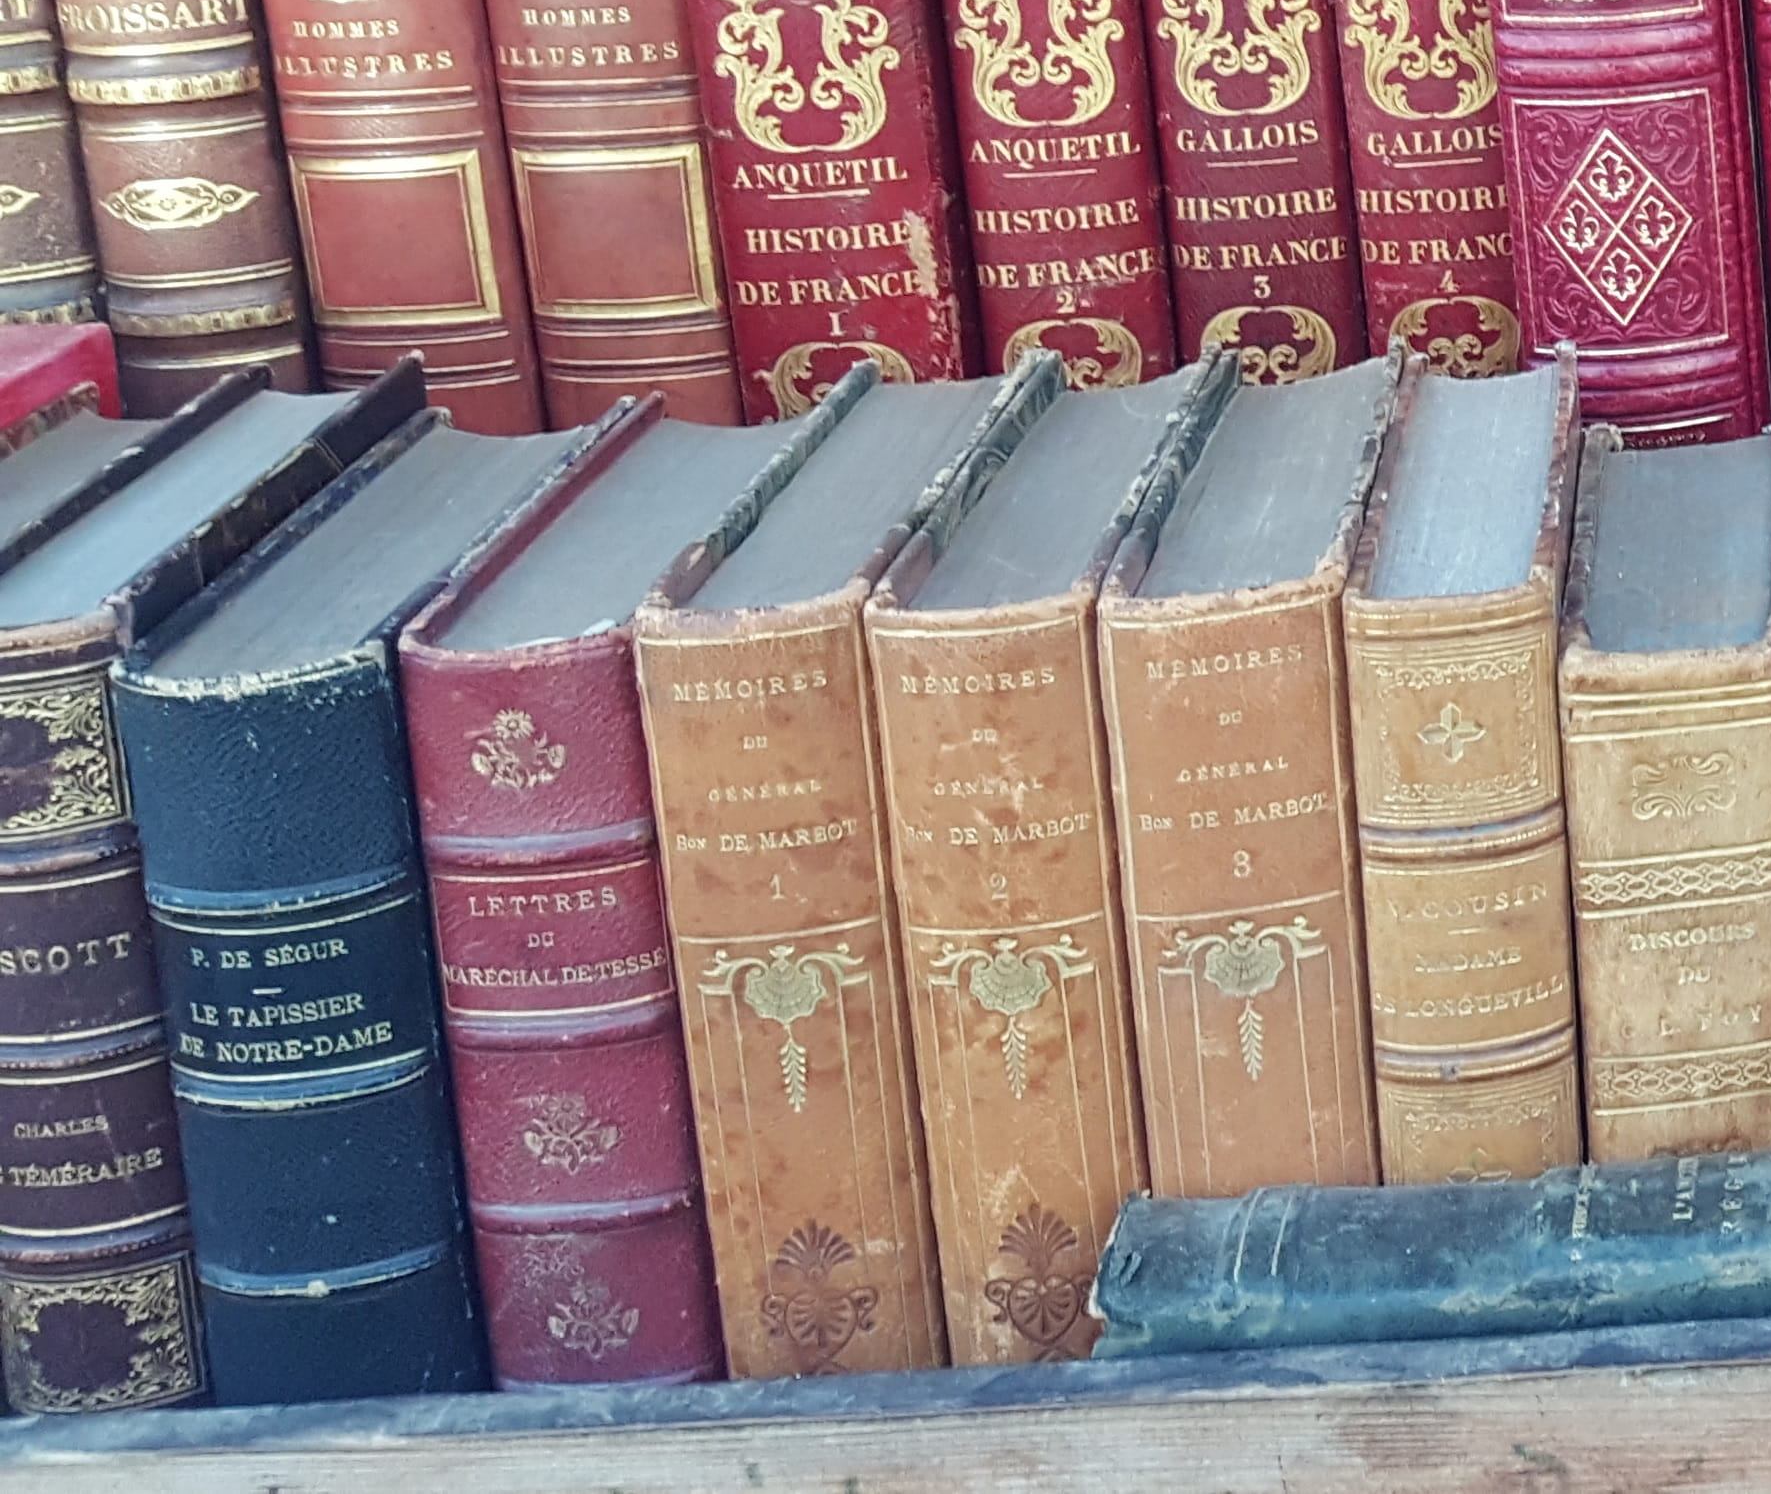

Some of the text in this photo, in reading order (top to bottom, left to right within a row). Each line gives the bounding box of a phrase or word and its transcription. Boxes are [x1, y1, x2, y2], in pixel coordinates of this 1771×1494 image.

[292, 18, 401, 39] HOMMES
[522, 5, 632, 27] HOMMES
[276, 49, 455, 79] ILLUSTRES
[499, 41, 681, 67] ILLUSTRES
[970, 130, 1142, 170] ANQUETIL
[1176, 118, 1320, 155] GALLOIS
[1367, 122, 1503, 157] GALLOIS
[732, 156, 909, 195] ANQUETIL
[976, 197, 1140, 235] HISTOIRE
[1175, 186, 1337, 222] HISTOIRE
[745, 219, 914, 255] HISTOIRE
[978, 244, 1156, 289] DE FRANCE
[1174, 235, 1348, 272] DE FRANCE
[735, 268, 922, 306] DE FRANCE
[1253, 274, 1272, 299] 3
[1441, 270, 1460, 294] 4
[1055, 291, 1077, 315] 2
[673, 670, 830, 704] MÉMOIRES
[742, 735, 769, 750] DU
[707, 777, 823, 804] GÉNÉRAL
[468, 885, 619, 918] LETTRES
[770, 874, 786, 901] 1
[190, 937, 349, 969] P. DE SÉGUR
[528, 932, 557, 950] DU
[1629, 921, 1755, 953] DISCOURS
[1677, 965, 1712, 986] DU
[190, 993, 366, 1029] LE TAPISSIER
[179, 1021, 393, 1064] DE NOTRE-DAME
[13, 1115, 109, 1140] CHARLES
[8, 1146, 163, 1189] TÉMÉRAIRE
